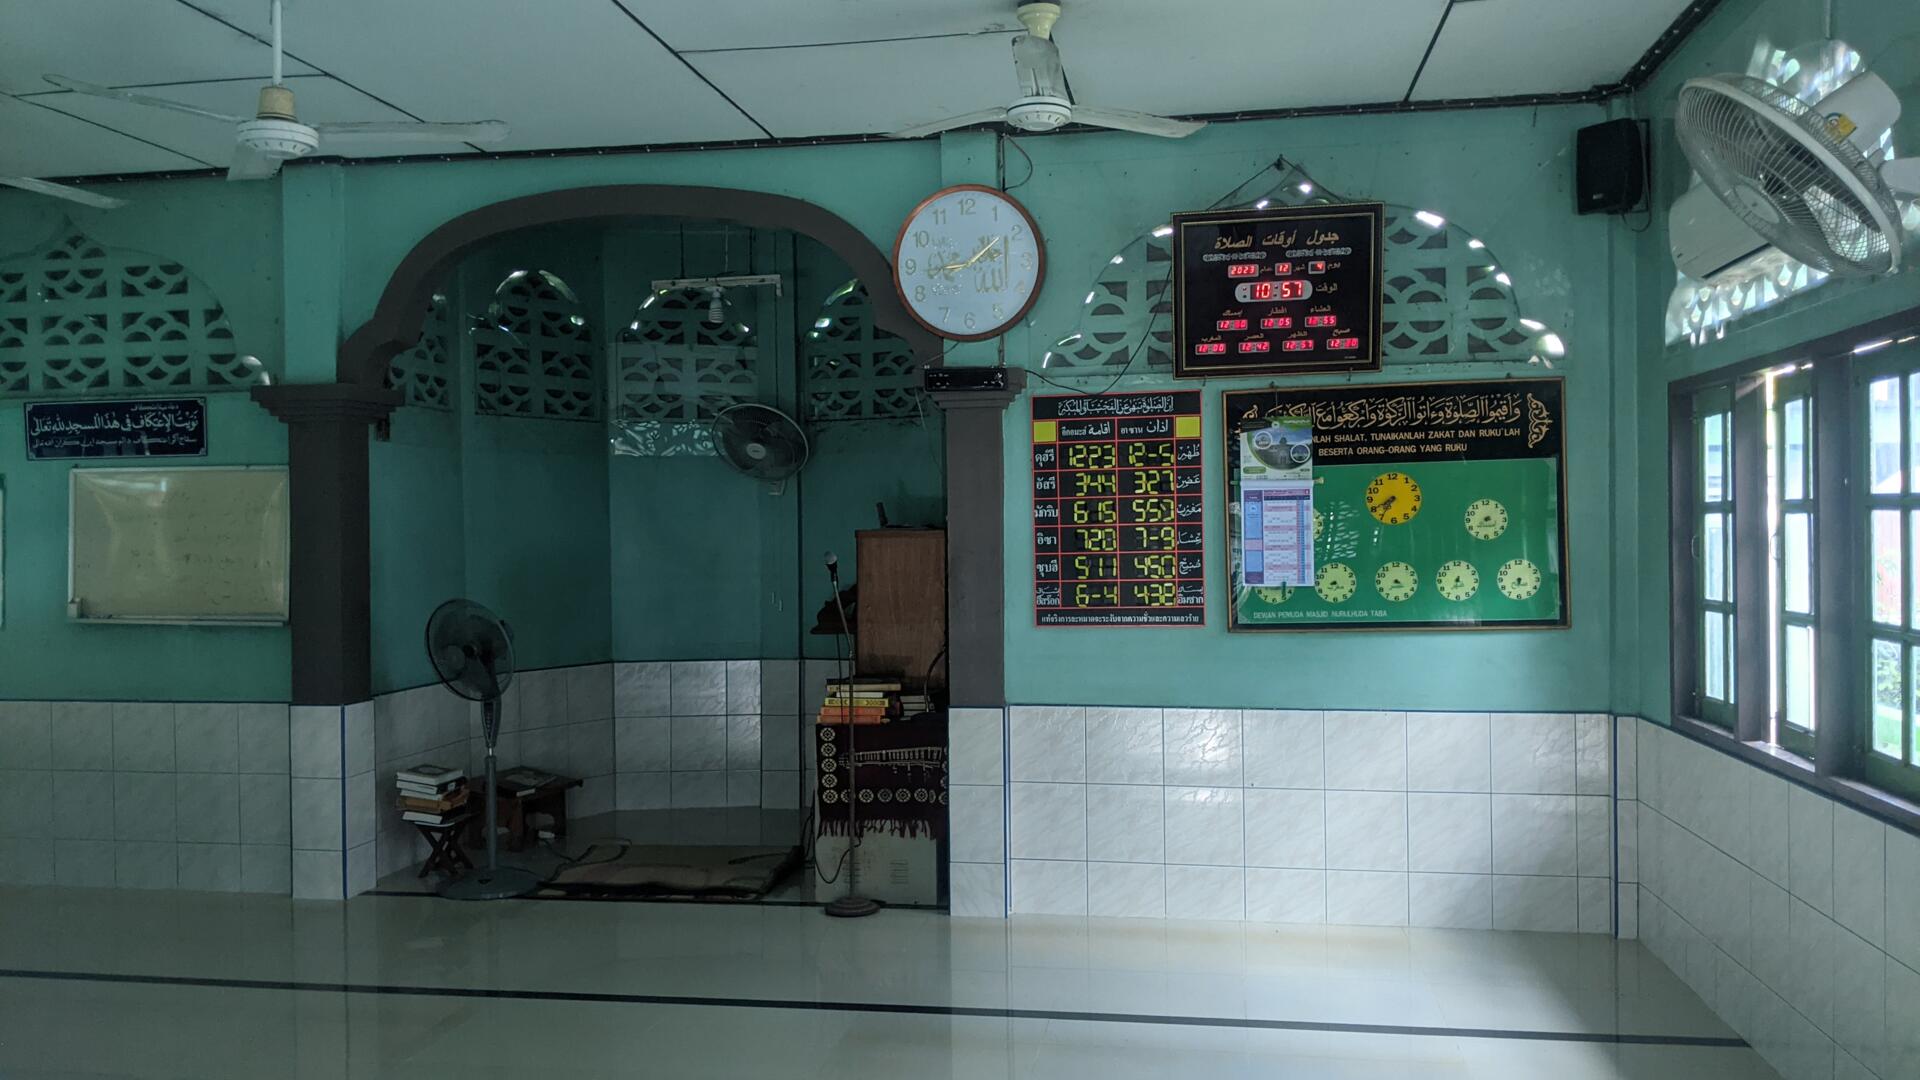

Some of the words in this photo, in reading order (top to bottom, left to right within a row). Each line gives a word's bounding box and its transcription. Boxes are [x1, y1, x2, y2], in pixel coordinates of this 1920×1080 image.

[957, 198, 977, 216] 12
[991, 206, 998, 222] 1
[932, 208, 947, 225] 11
[912, 230, 929, 248] 10
[1011, 224, 1023, 241] 2
[905, 258, 917, 275] 9
[1021, 252, 1032, 272] 3
[1230, 265, 1255, 275] 2023
[1279, 264, 1289, 272] 12
[914, 285, 926, 302] 8
[1255, 281, 1302, 298] 10:57
[938, 306, 950, 323] 7
[992, 302, 1004, 320] 5
[964, 312, 976, 329] 6
[1371, 431, 1425, 442] TUNAIKANLAH
[1428, 430, 1455, 440] ZAKAT
[1459, 429, 1476, 438] DAN
[1318, 448, 1354, 457] BESERTA
[1356, 445, 1417, 456] ORANG-ORANG
[1420, 444, 1442, 453] YANG
[1445, 443, 1468, 452] RUKU
[1075, 472, 1116, 497] 344
[1135, 470, 1174, 495] 327
[1411, 484, 1418, 492] 2
[1076, 528, 1116, 550] 720
[1134, 554, 1175, 578] 450
[1253, 611, 1276, 619] DEWAN
[1306, 610, 1328, 618] MASJID
[1371, 609, 1387, 617] TABA
